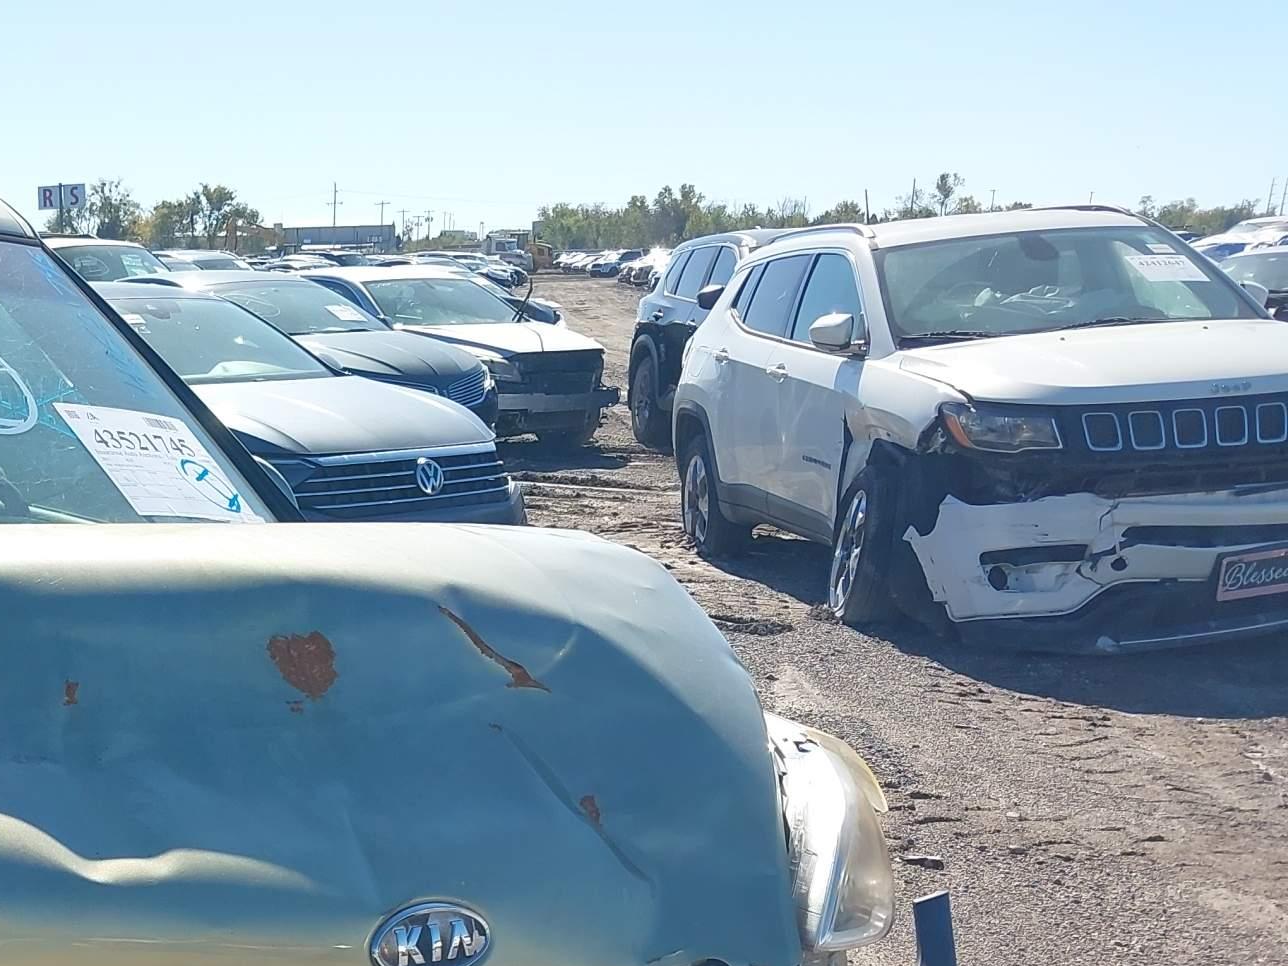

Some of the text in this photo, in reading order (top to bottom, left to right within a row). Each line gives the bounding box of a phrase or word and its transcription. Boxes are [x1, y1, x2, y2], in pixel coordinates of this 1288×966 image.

[42, 188, 54, 208] R
[69, 186, 80, 206] S
[93, 428, 196, 458] 43521745
